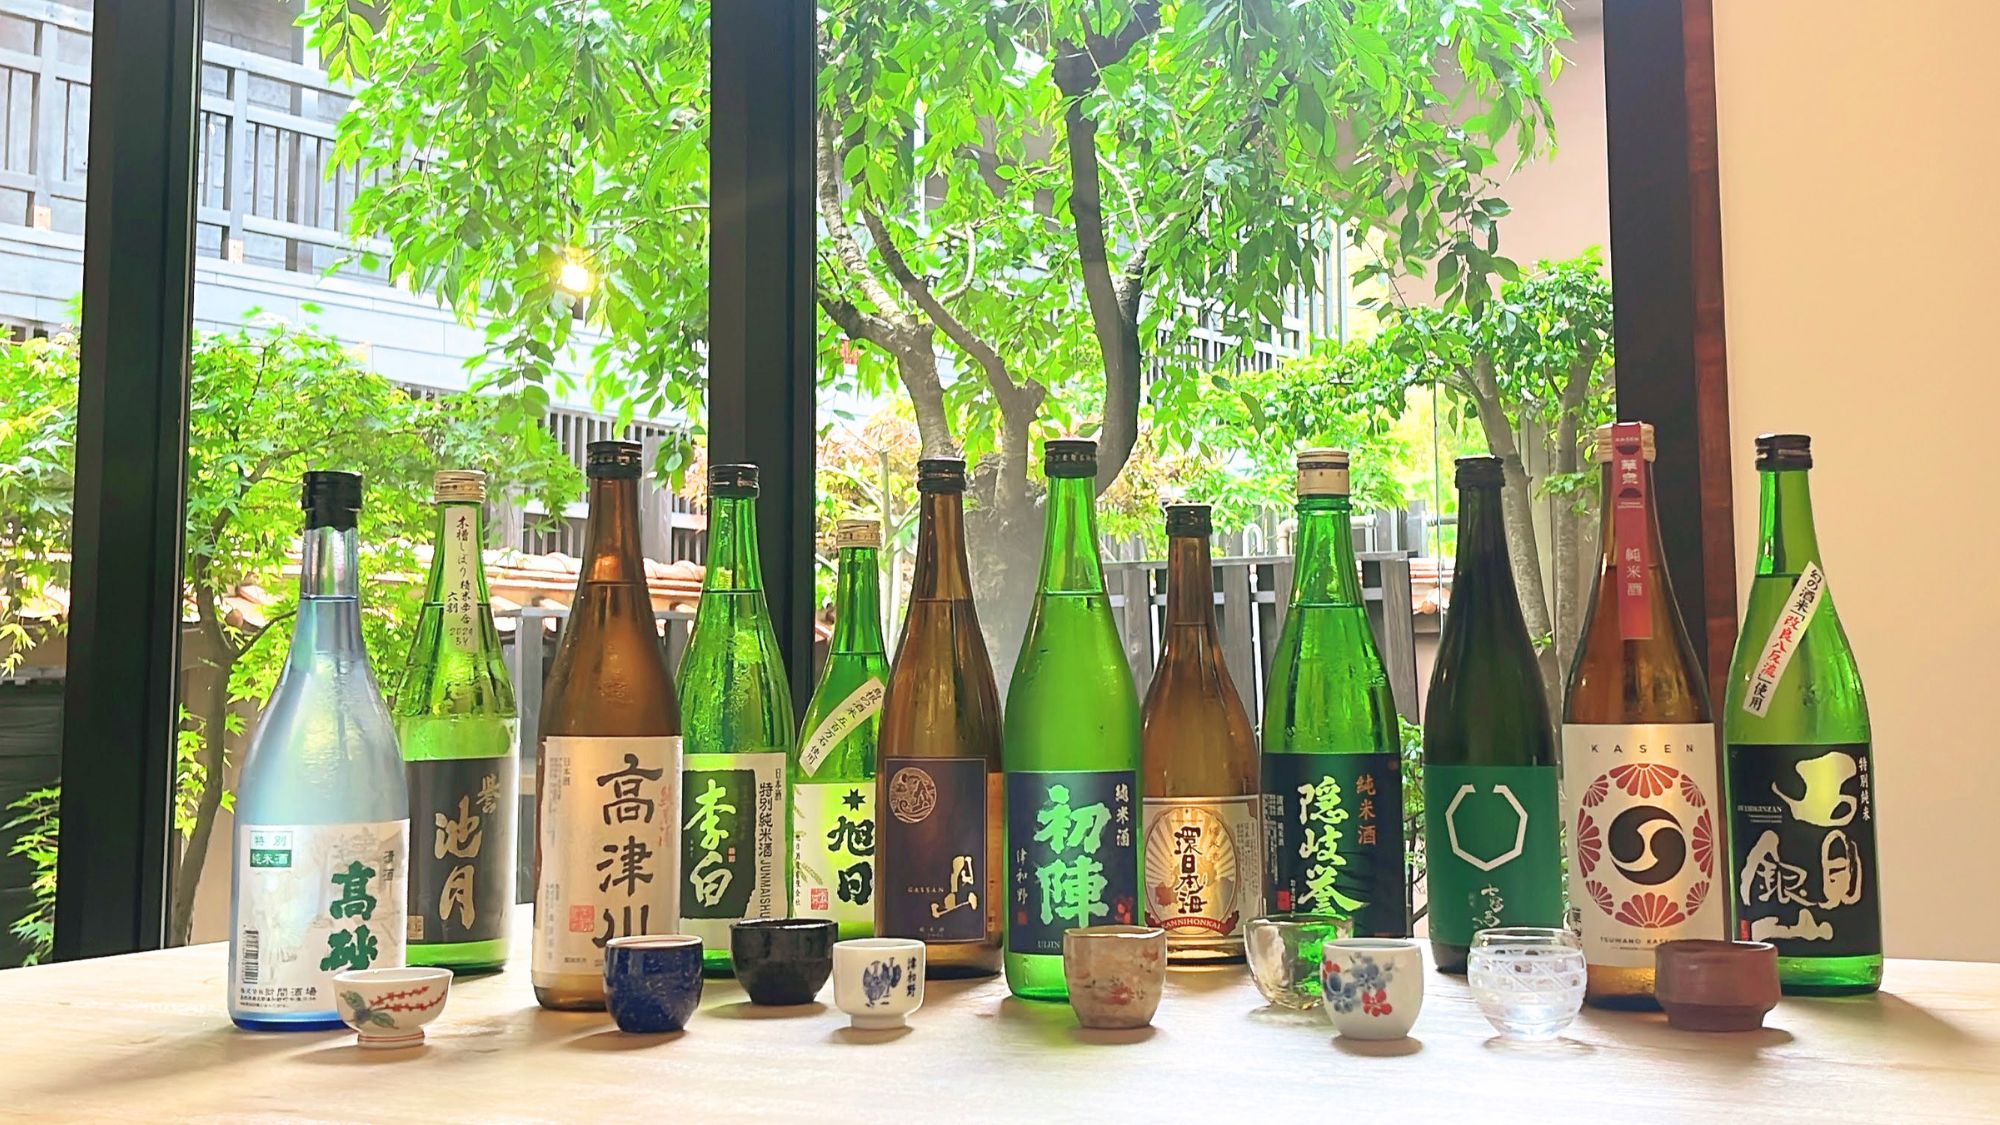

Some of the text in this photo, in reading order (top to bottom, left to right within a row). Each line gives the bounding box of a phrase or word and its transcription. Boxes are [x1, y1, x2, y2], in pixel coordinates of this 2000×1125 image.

[1625, 547, 1643, 597] 純米酒
[1591, 744, 1694, 754] KASEN
[683, 778, 737, 908] 李白
[758, 781, 774, 858] 特別純米酒
[1115, 783, 1129, 847] 純米酒
[1297, 775, 1371, 915] 隠岐誉
[1356, 774, 1377, 846] 純米酒
[251, 852, 290, 866] 純米酒
[434, 795, 483, 931] 池月
[592, 753, 664, 949] 高津川
[931, 855, 978, 918] 月山
[1015, 847, 1029, 905] 津和野
[1033, 784, 1112, 929] 初陣
[1173, 826, 1208, 915] 環日本海
